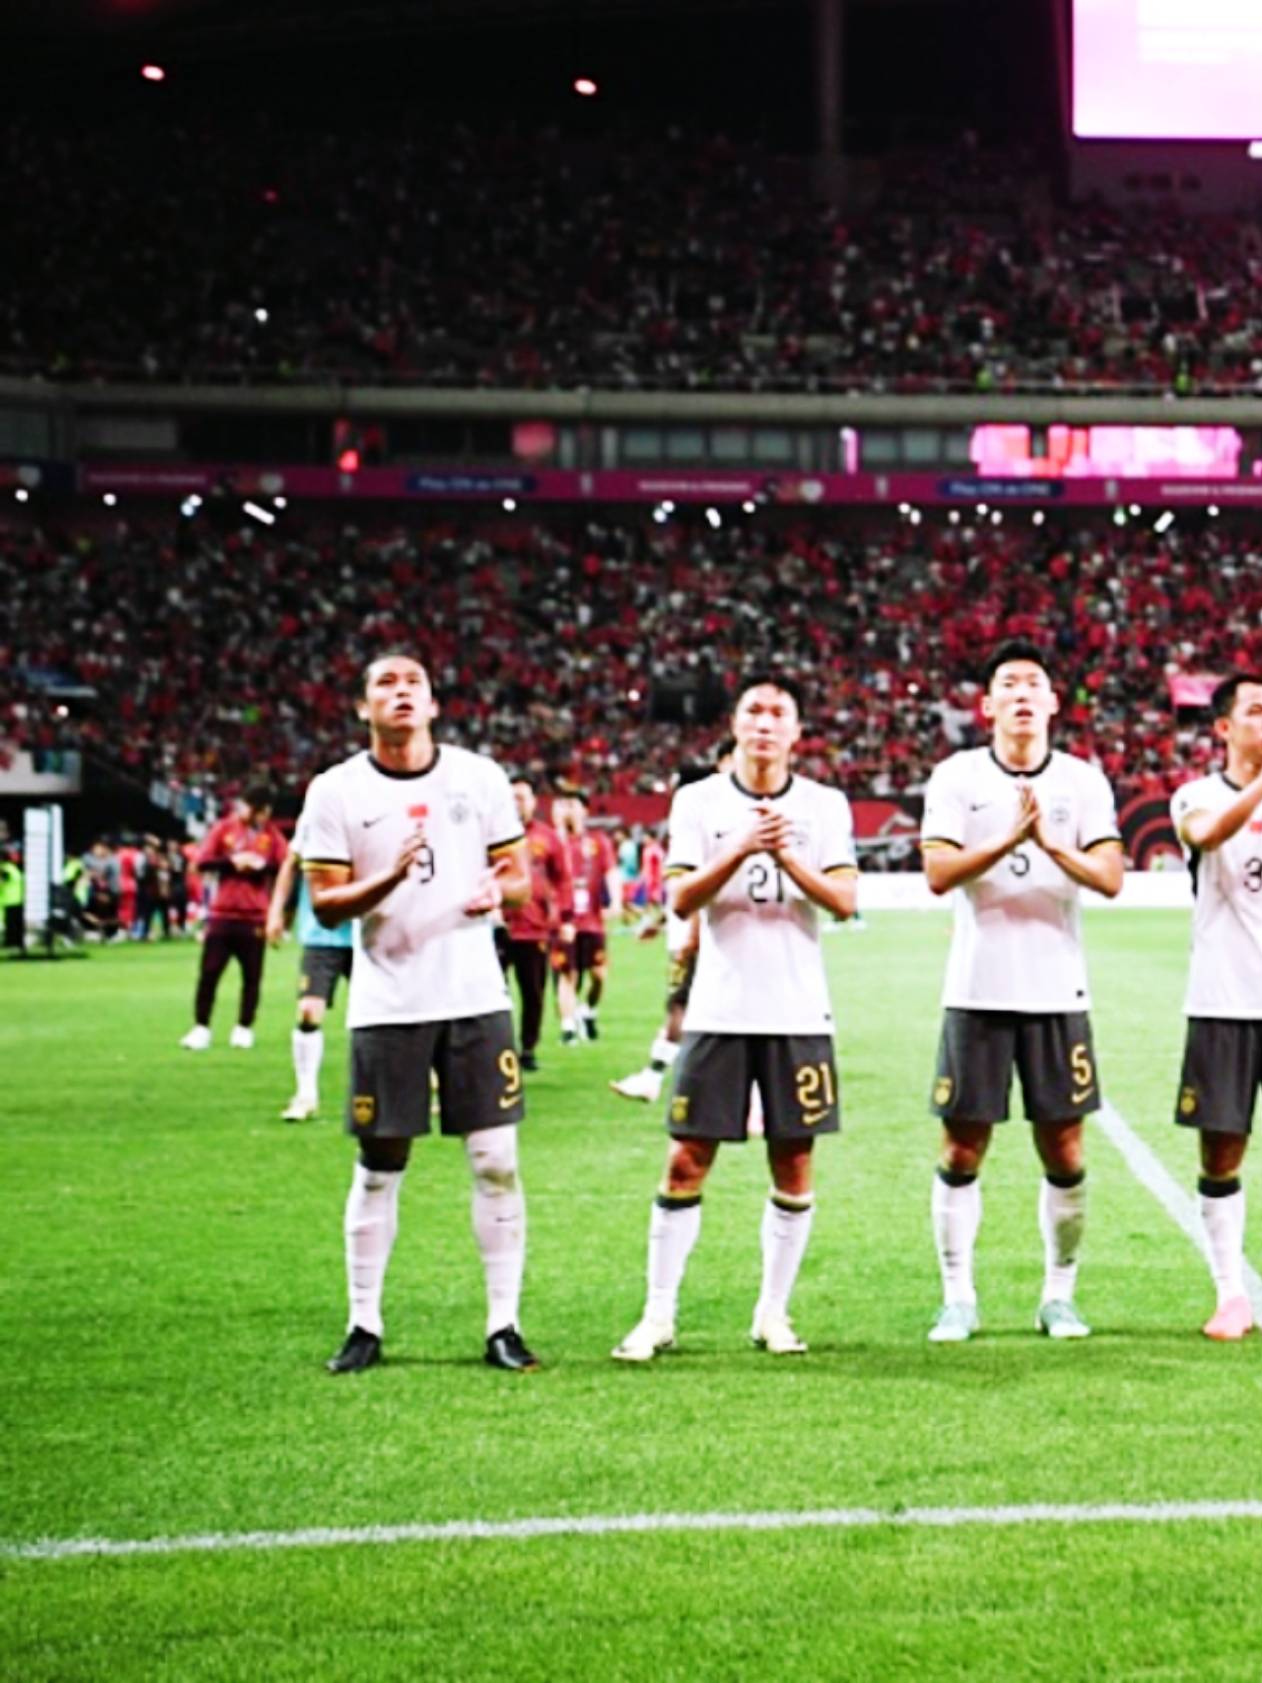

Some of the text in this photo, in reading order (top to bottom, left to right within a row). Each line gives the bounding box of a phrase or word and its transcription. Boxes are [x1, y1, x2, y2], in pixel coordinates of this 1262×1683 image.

[414, 843, 435, 885] 9
[747, 863, 784, 903] 21
[499, 1049, 520, 1094] 9
[796, 1062, 834, 1109] 21
[1071, 1044, 1092, 1087] 5
